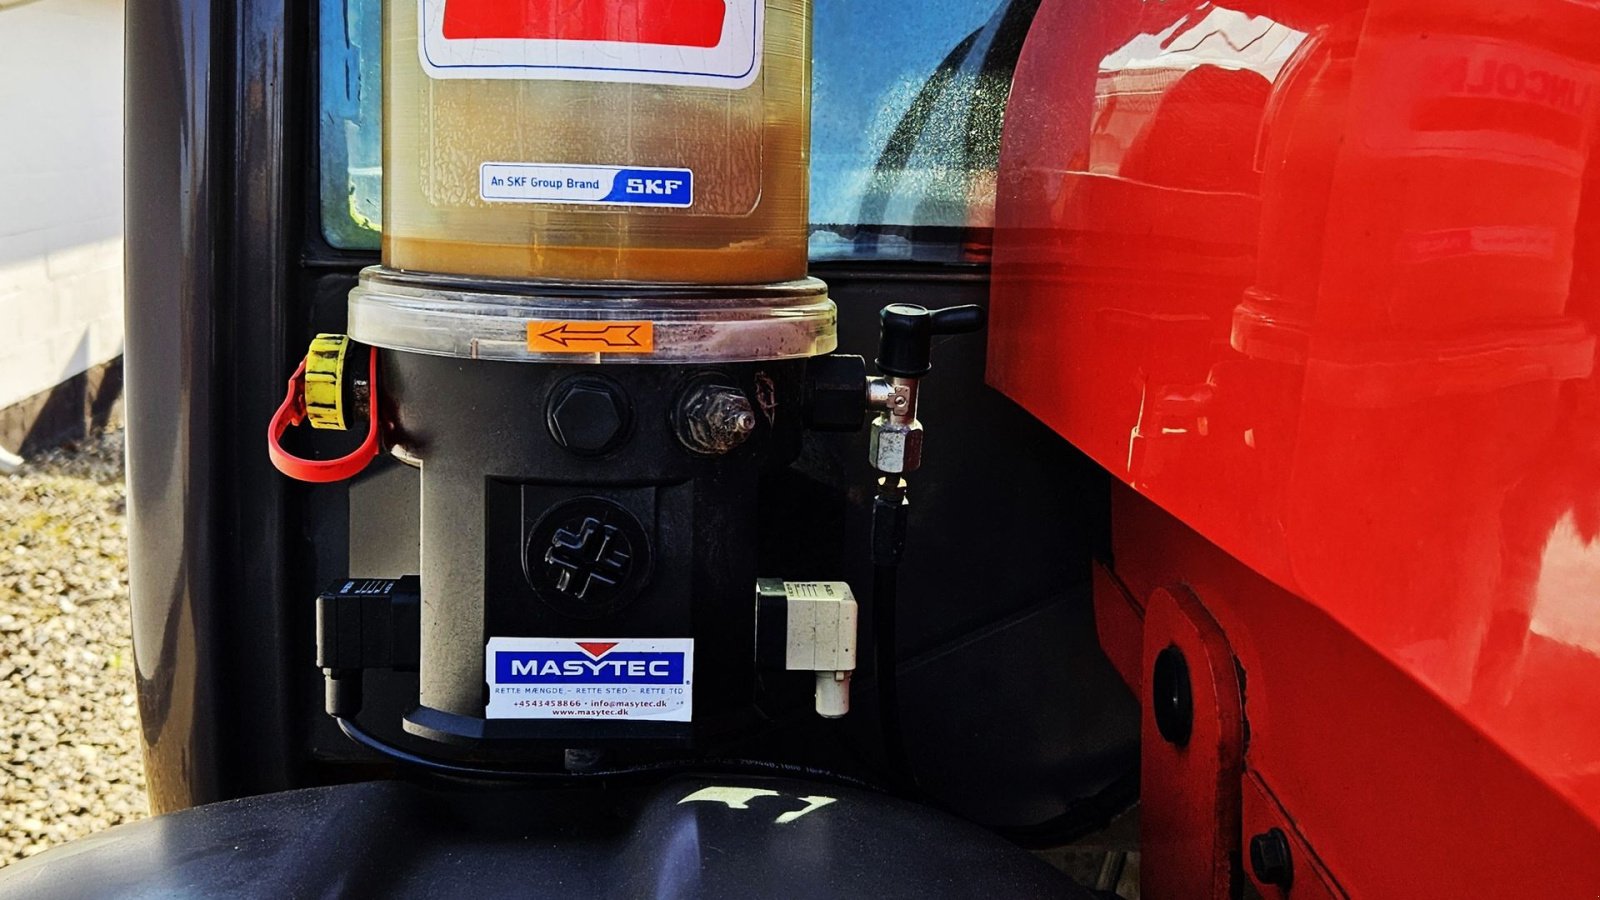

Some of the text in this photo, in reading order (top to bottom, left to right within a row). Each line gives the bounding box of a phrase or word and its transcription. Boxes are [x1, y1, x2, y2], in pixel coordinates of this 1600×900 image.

[491, 176, 599, 189] An SKF Group Brand
[626, 178, 682, 195] SKF
[511, 660, 669, 676] MASYTEC
[590, 700, 667, 708] info@masytec.dk
[552, 709, 629, 717] www.masytec.dk
